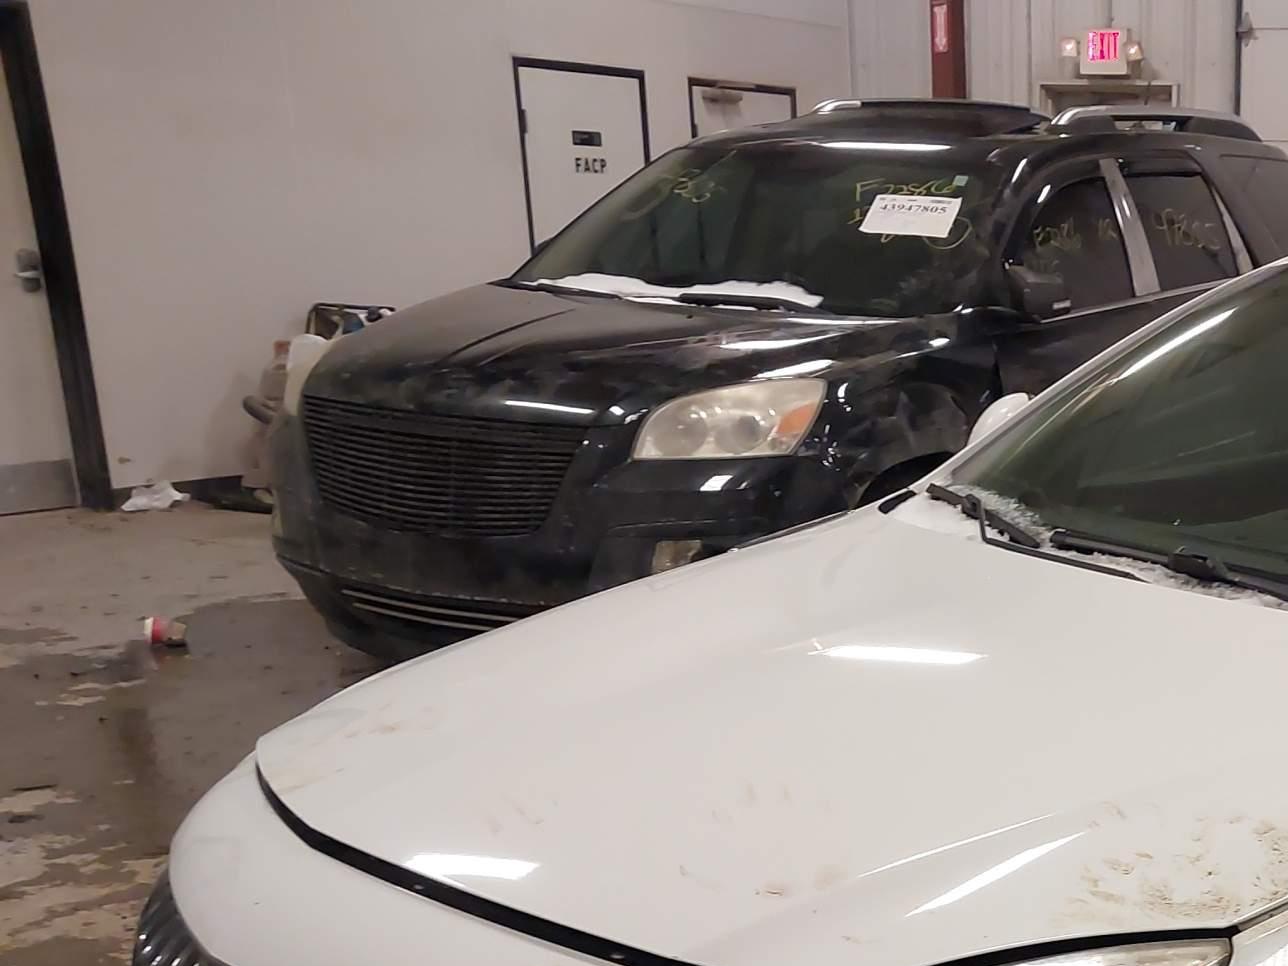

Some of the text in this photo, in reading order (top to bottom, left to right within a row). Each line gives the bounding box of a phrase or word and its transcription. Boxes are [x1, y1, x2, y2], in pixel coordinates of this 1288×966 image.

[1087, 31, 1120, 62] EXIT
[574, 157, 607, 174] FACP
[879, 203, 948, 215] 43947805
